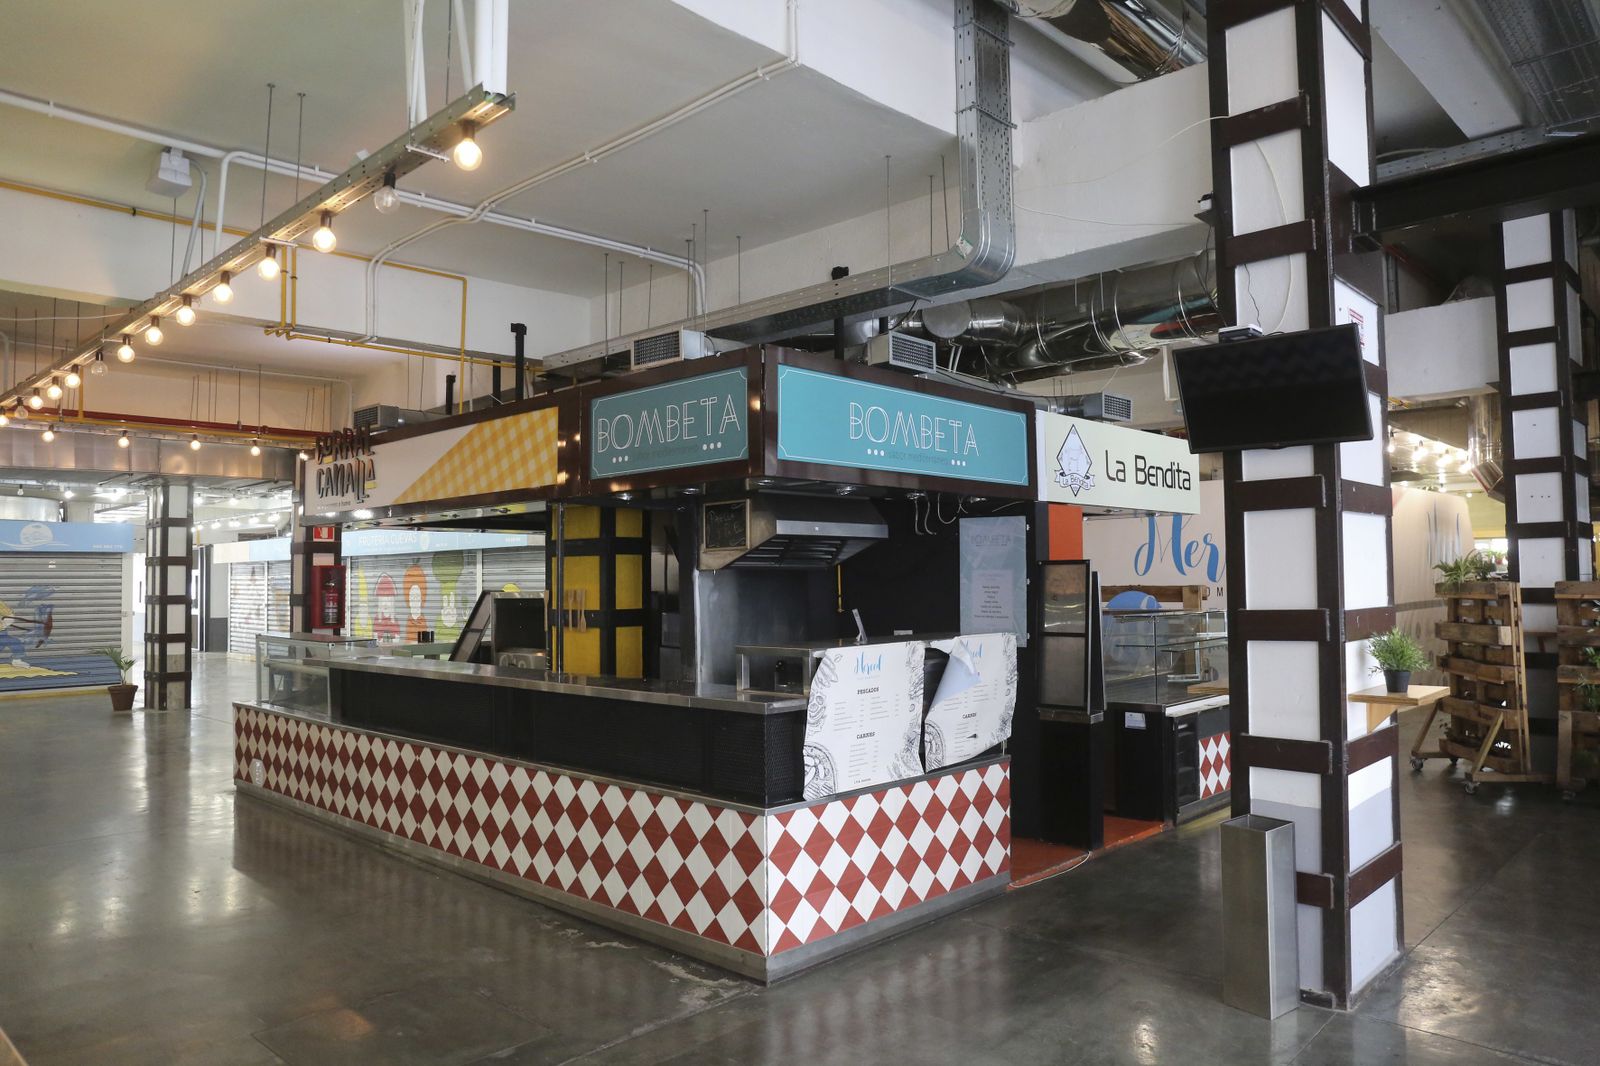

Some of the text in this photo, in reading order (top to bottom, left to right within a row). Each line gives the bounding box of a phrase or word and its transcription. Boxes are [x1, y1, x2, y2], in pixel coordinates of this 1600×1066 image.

[597, 394, 741, 453] BOMBETA
[849, 401, 980, 457] BOMBETA
[1105, 450, 1191, 491] La Bendita
